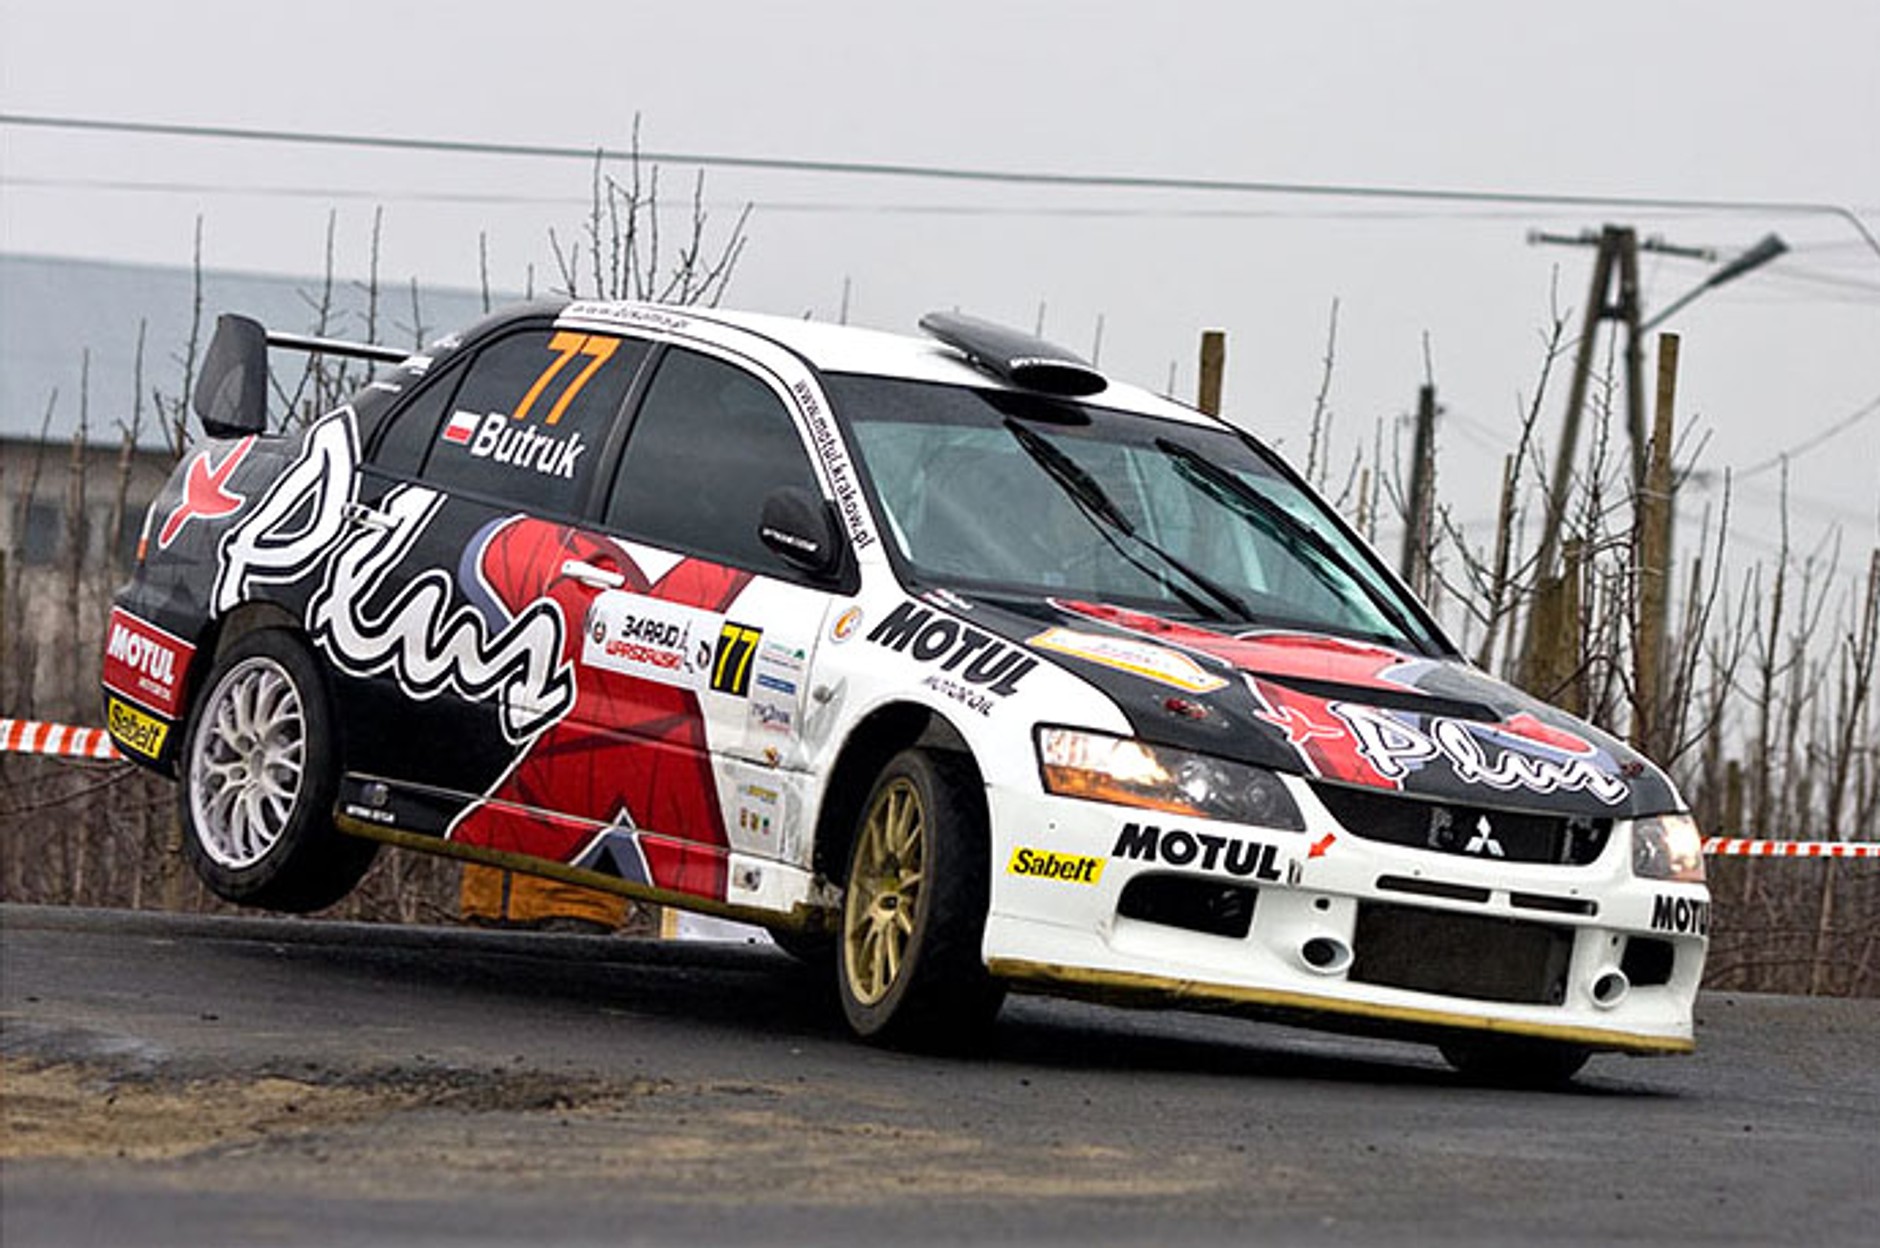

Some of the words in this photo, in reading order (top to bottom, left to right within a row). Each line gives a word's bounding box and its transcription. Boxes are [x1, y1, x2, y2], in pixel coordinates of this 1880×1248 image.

[513, 331, 622, 425] 77
[471, 412, 585, 478] Butruk
[106, 623, 175, 686] MOTUL
[714, 623, 762, 693] 77
[866, 600, 1039, 697] MOTUL
[1013, 848, 1098, 882] Sabelt
[1112, 822, 1282, 882] MOTUL
